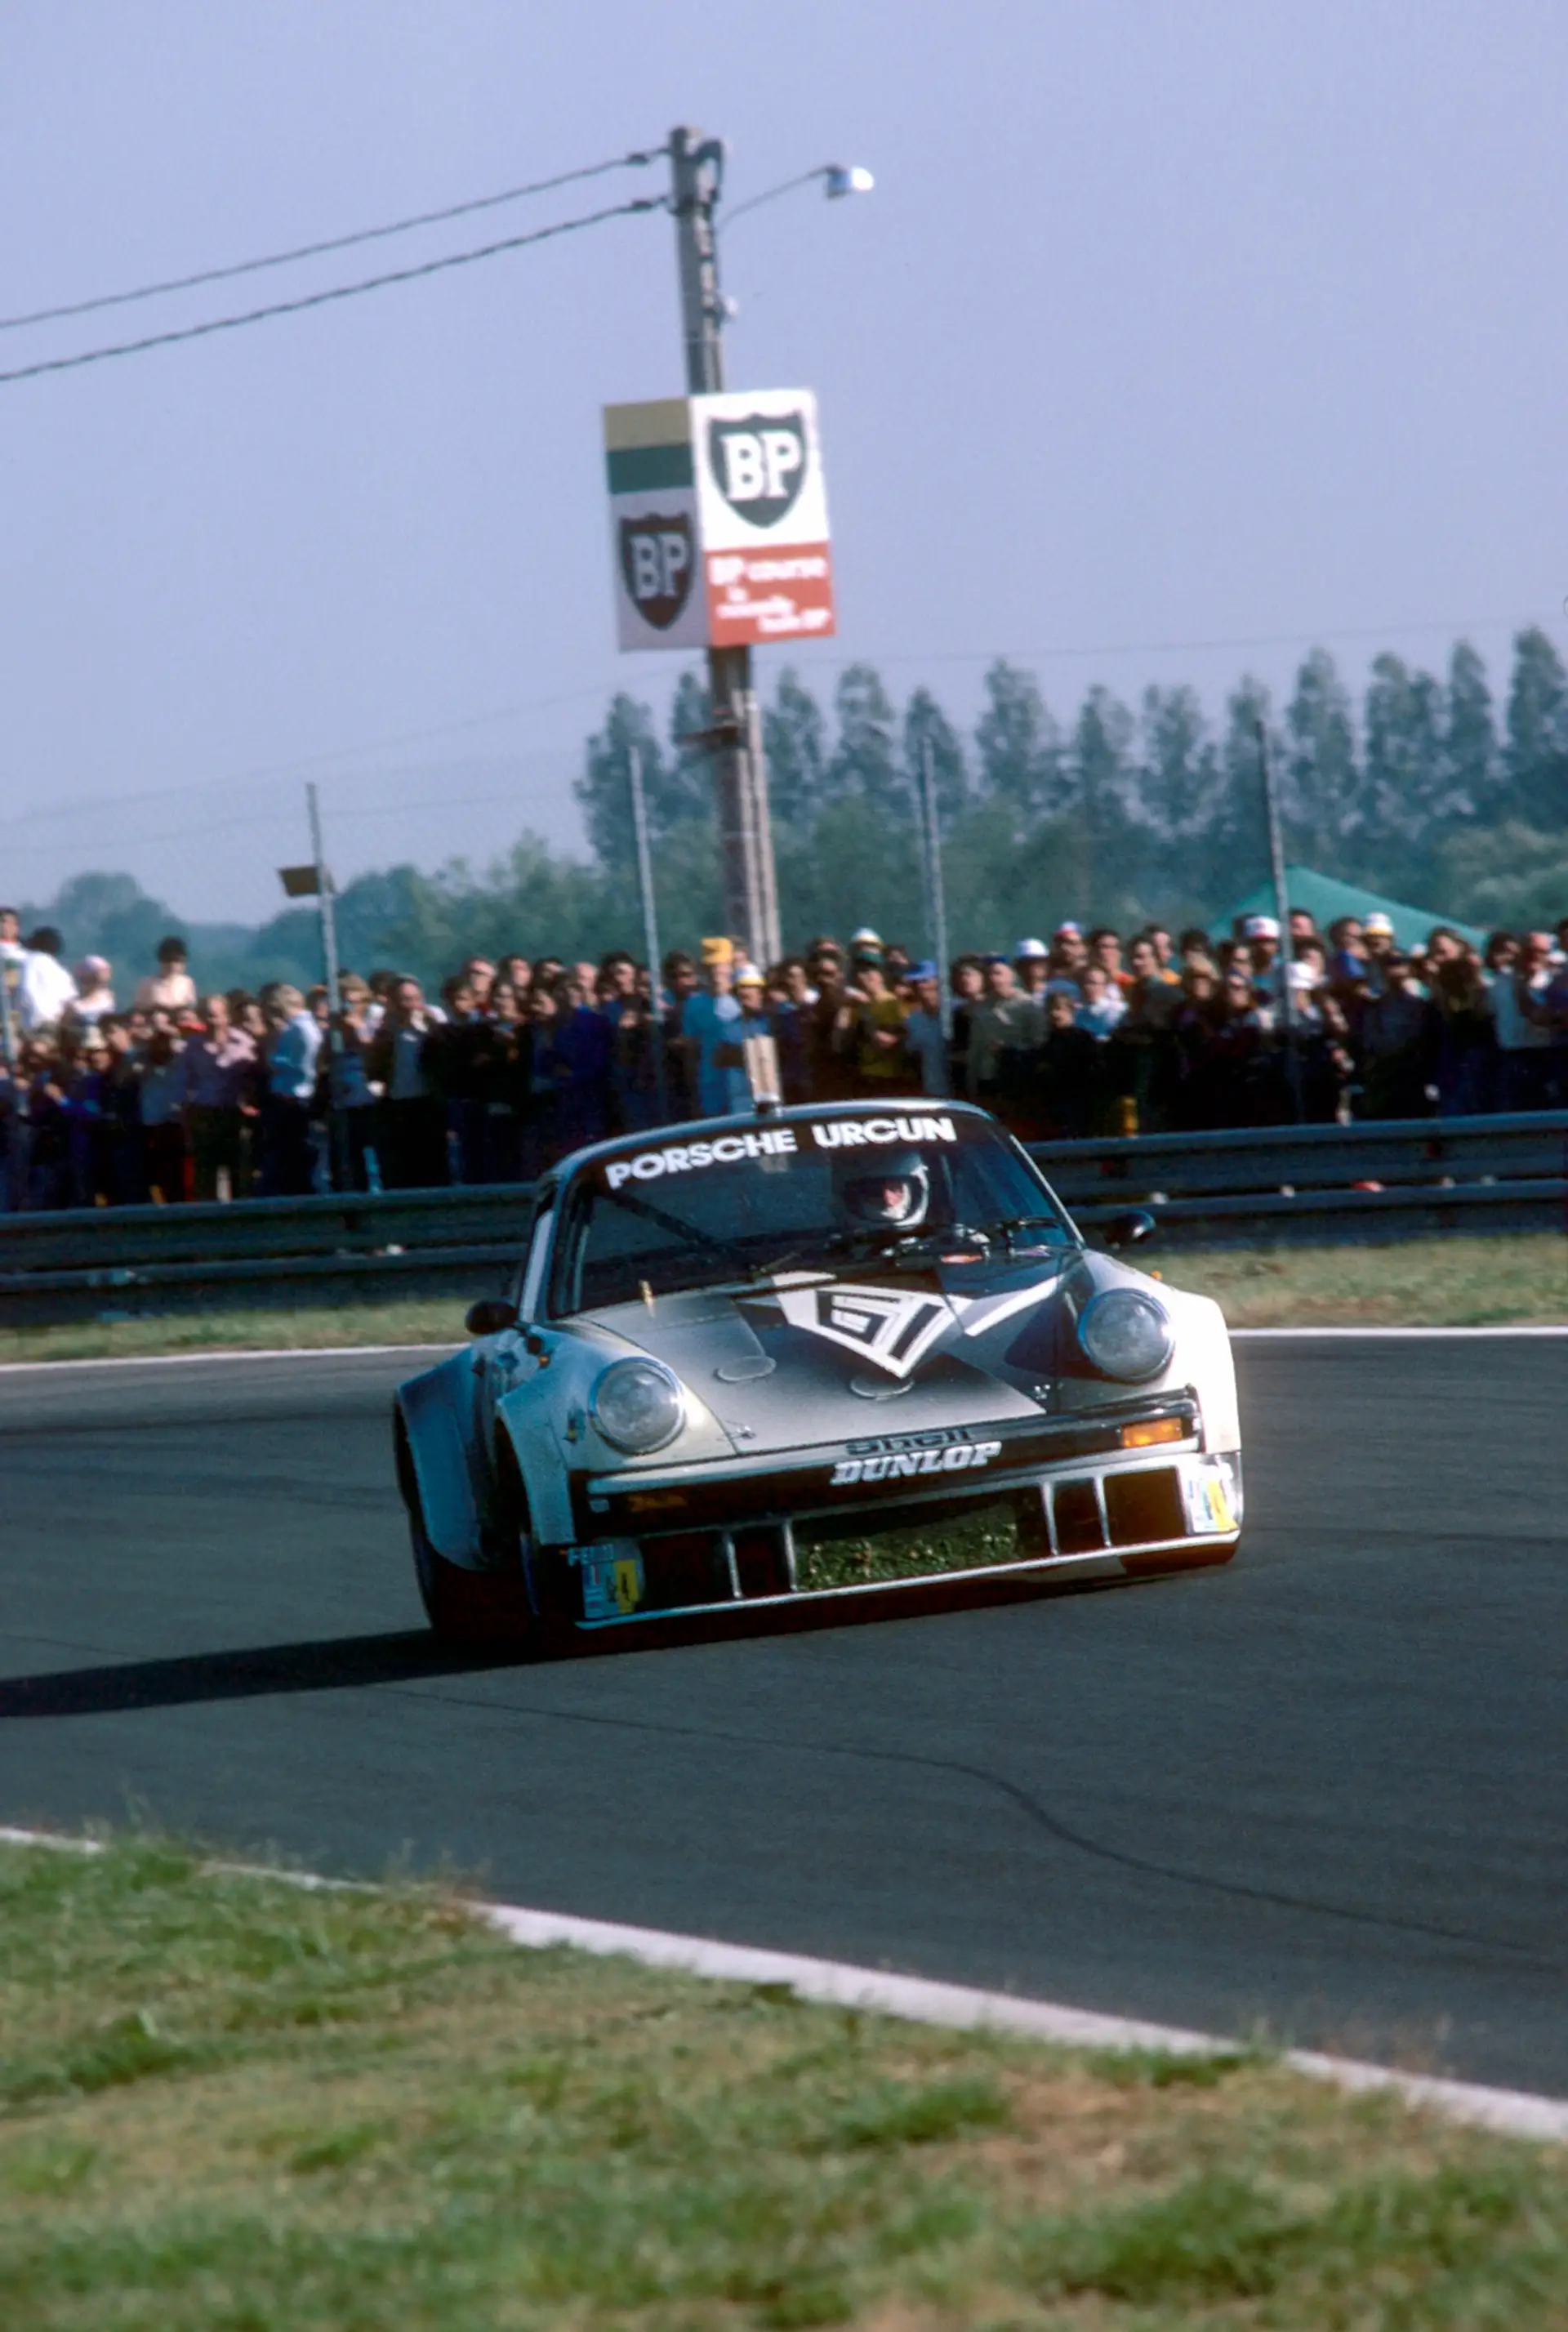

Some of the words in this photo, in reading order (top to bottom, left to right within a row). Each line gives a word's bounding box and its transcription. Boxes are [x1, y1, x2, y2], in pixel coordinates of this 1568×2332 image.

[719, 429, 800, 502] BP
[630, 533, 688, 600] BP
[605, 1127, 799, 1190] PORSCHE
[811, 1117, 958, 1148] URCUN
[830, 1440, 1003, 1487] DUNLOP
